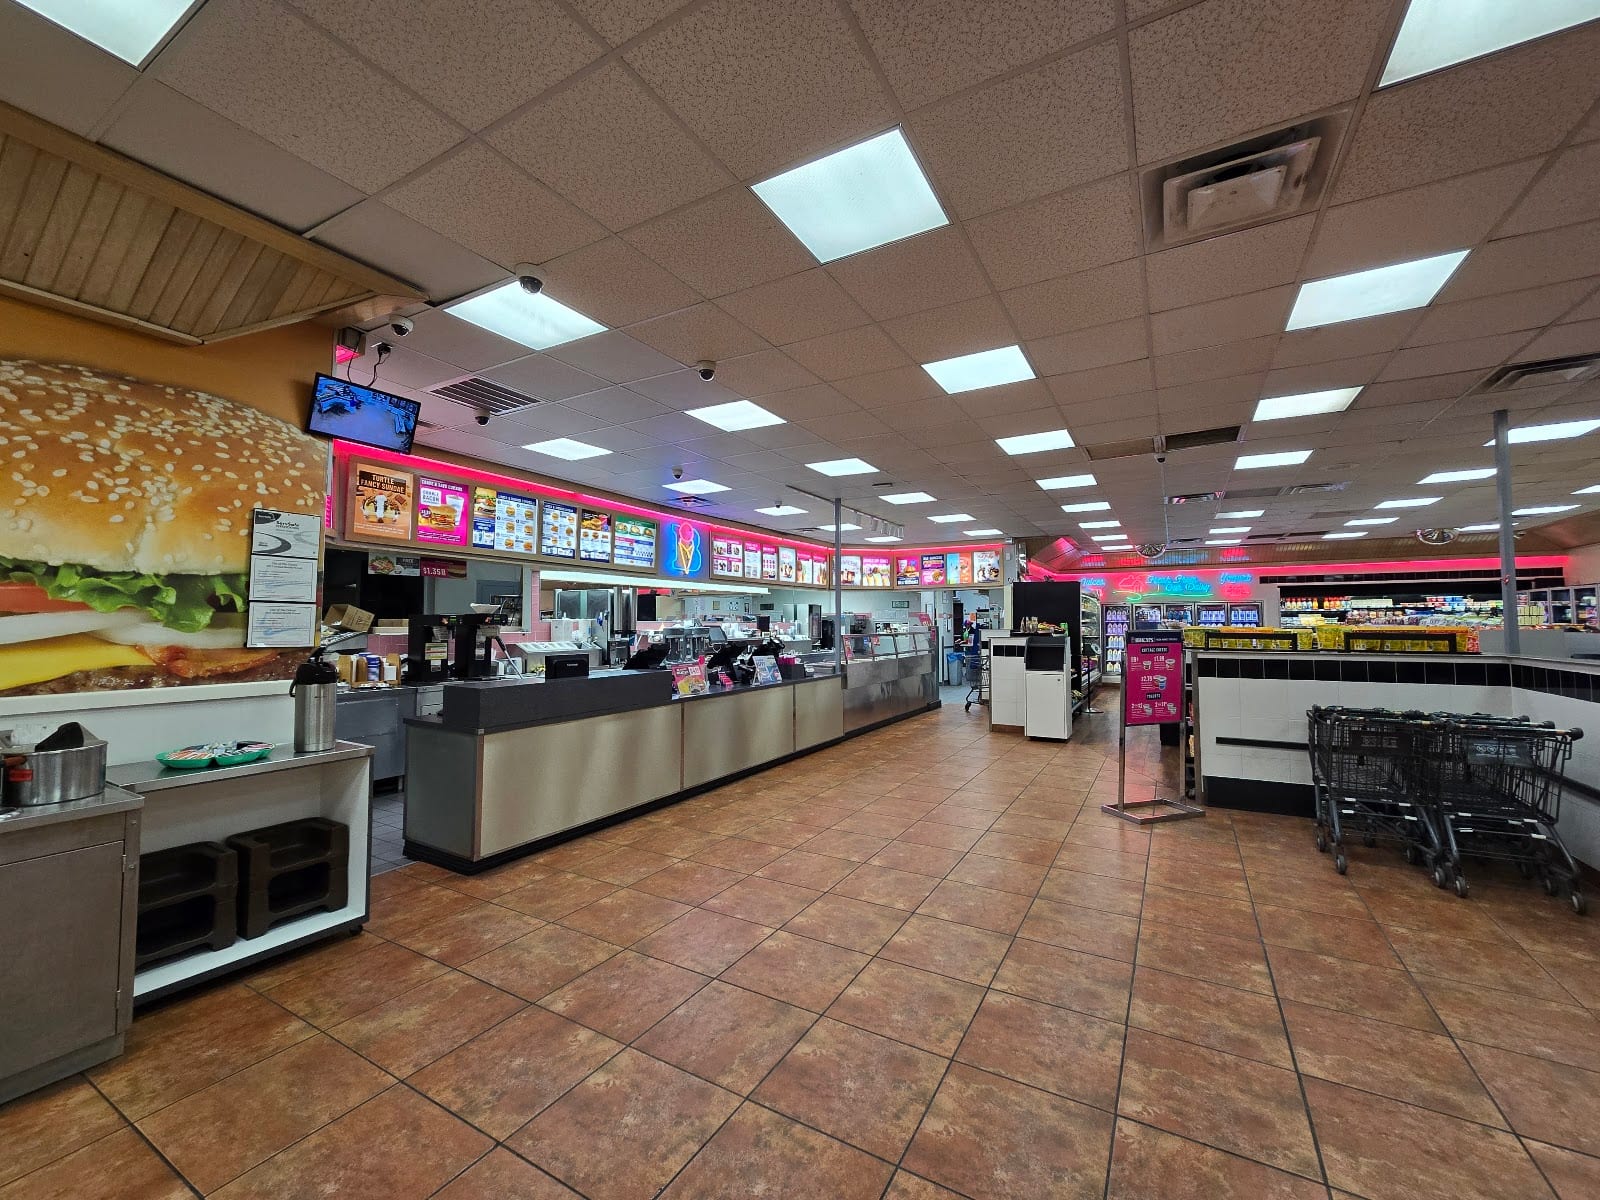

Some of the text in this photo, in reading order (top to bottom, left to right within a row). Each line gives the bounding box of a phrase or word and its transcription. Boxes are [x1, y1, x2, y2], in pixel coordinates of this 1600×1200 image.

[360, 478, 405, 493] FANCY SUNDAE
[372, 474, 395, 485] TURTLE
